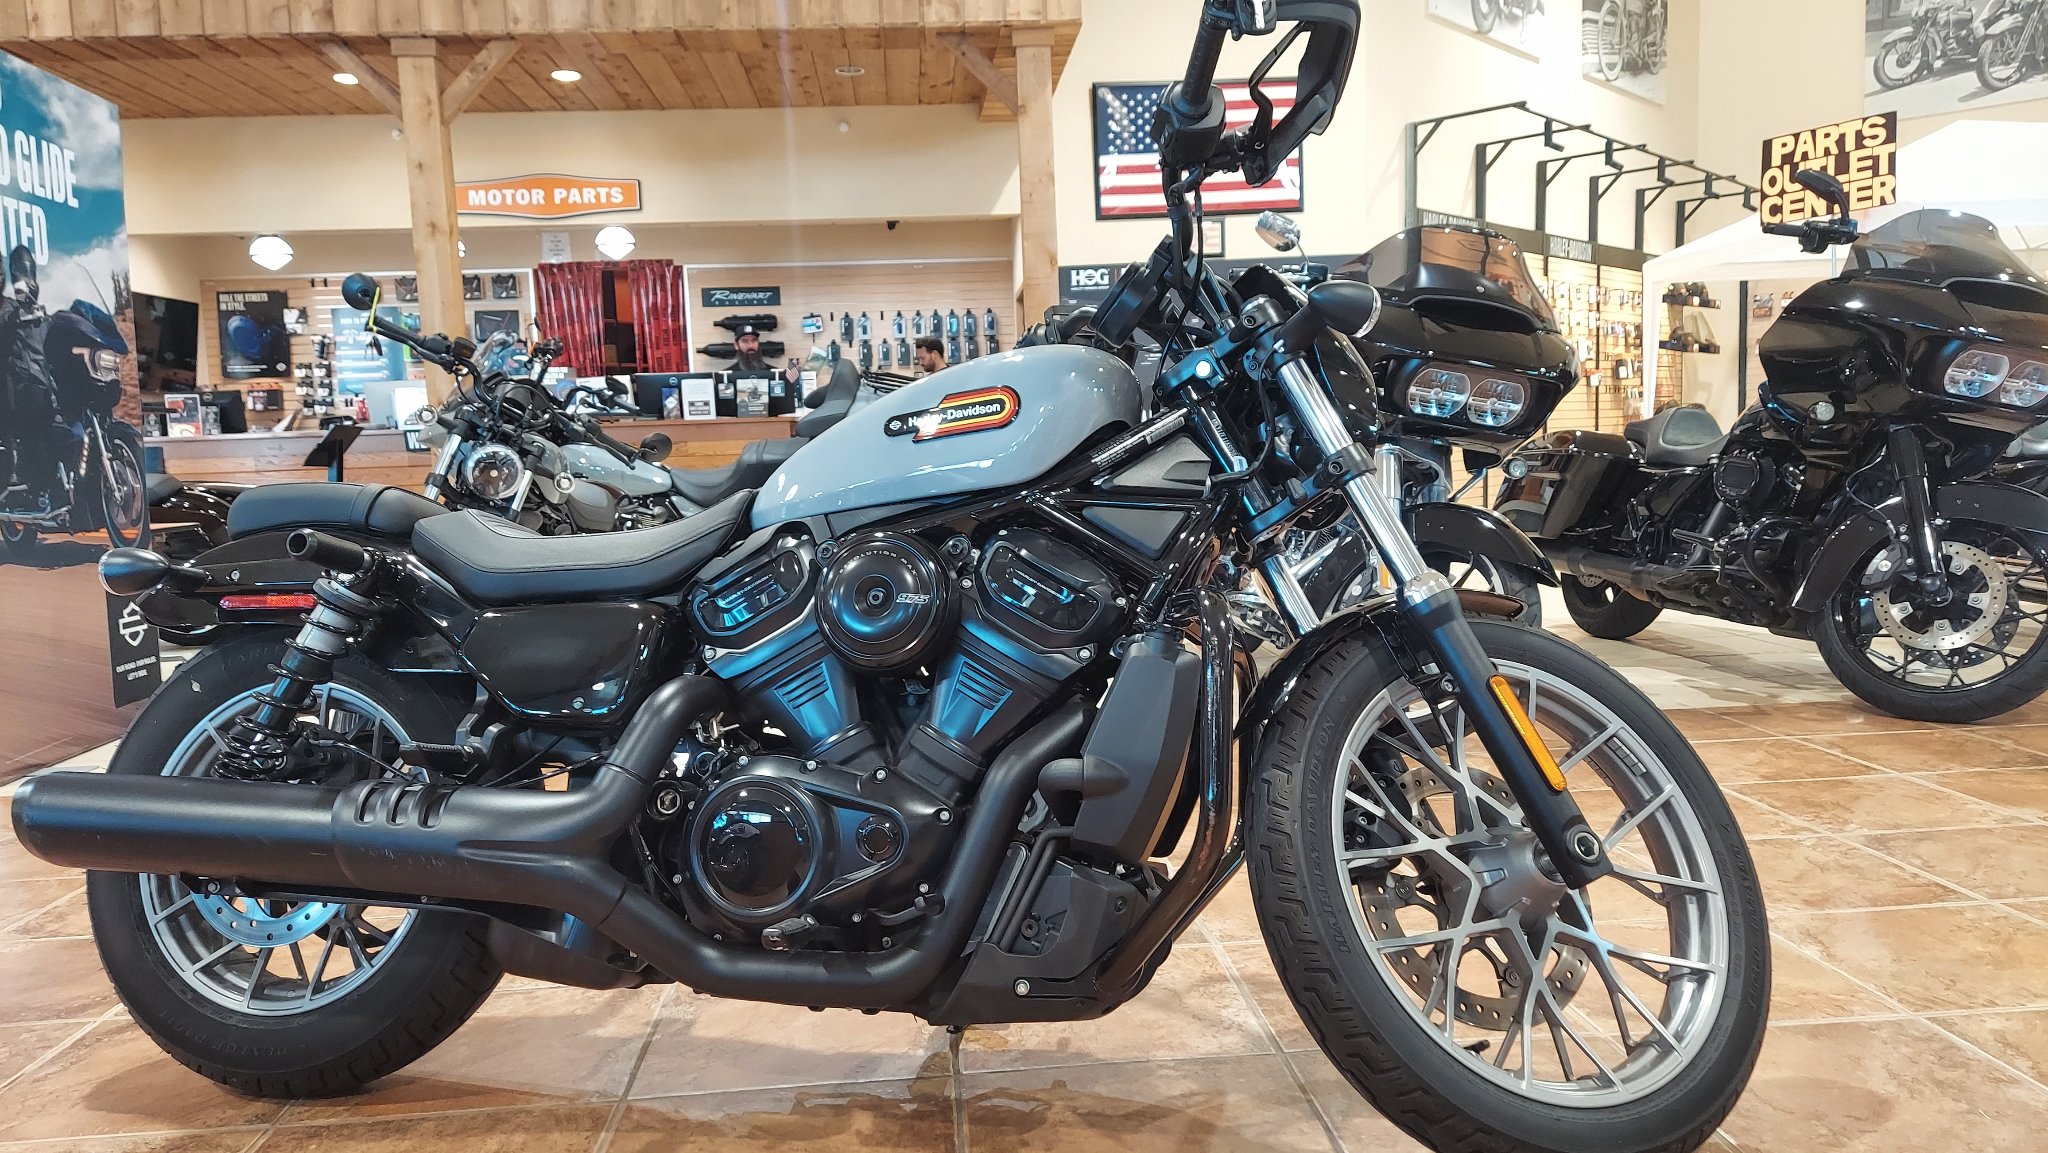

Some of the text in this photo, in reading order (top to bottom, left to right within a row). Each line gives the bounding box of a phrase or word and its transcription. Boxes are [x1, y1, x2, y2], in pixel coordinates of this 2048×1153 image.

[1771, 116, 1887, 167] PARTS
[14, 129, 79, 208] GLIDE
[468, 186, 624, 206] MOTOR PARTS
[1070, 268, 1110, 286] HOG
[710, 290, 773, 302] RINEHART
[900, 557, 918, 577] MAX
